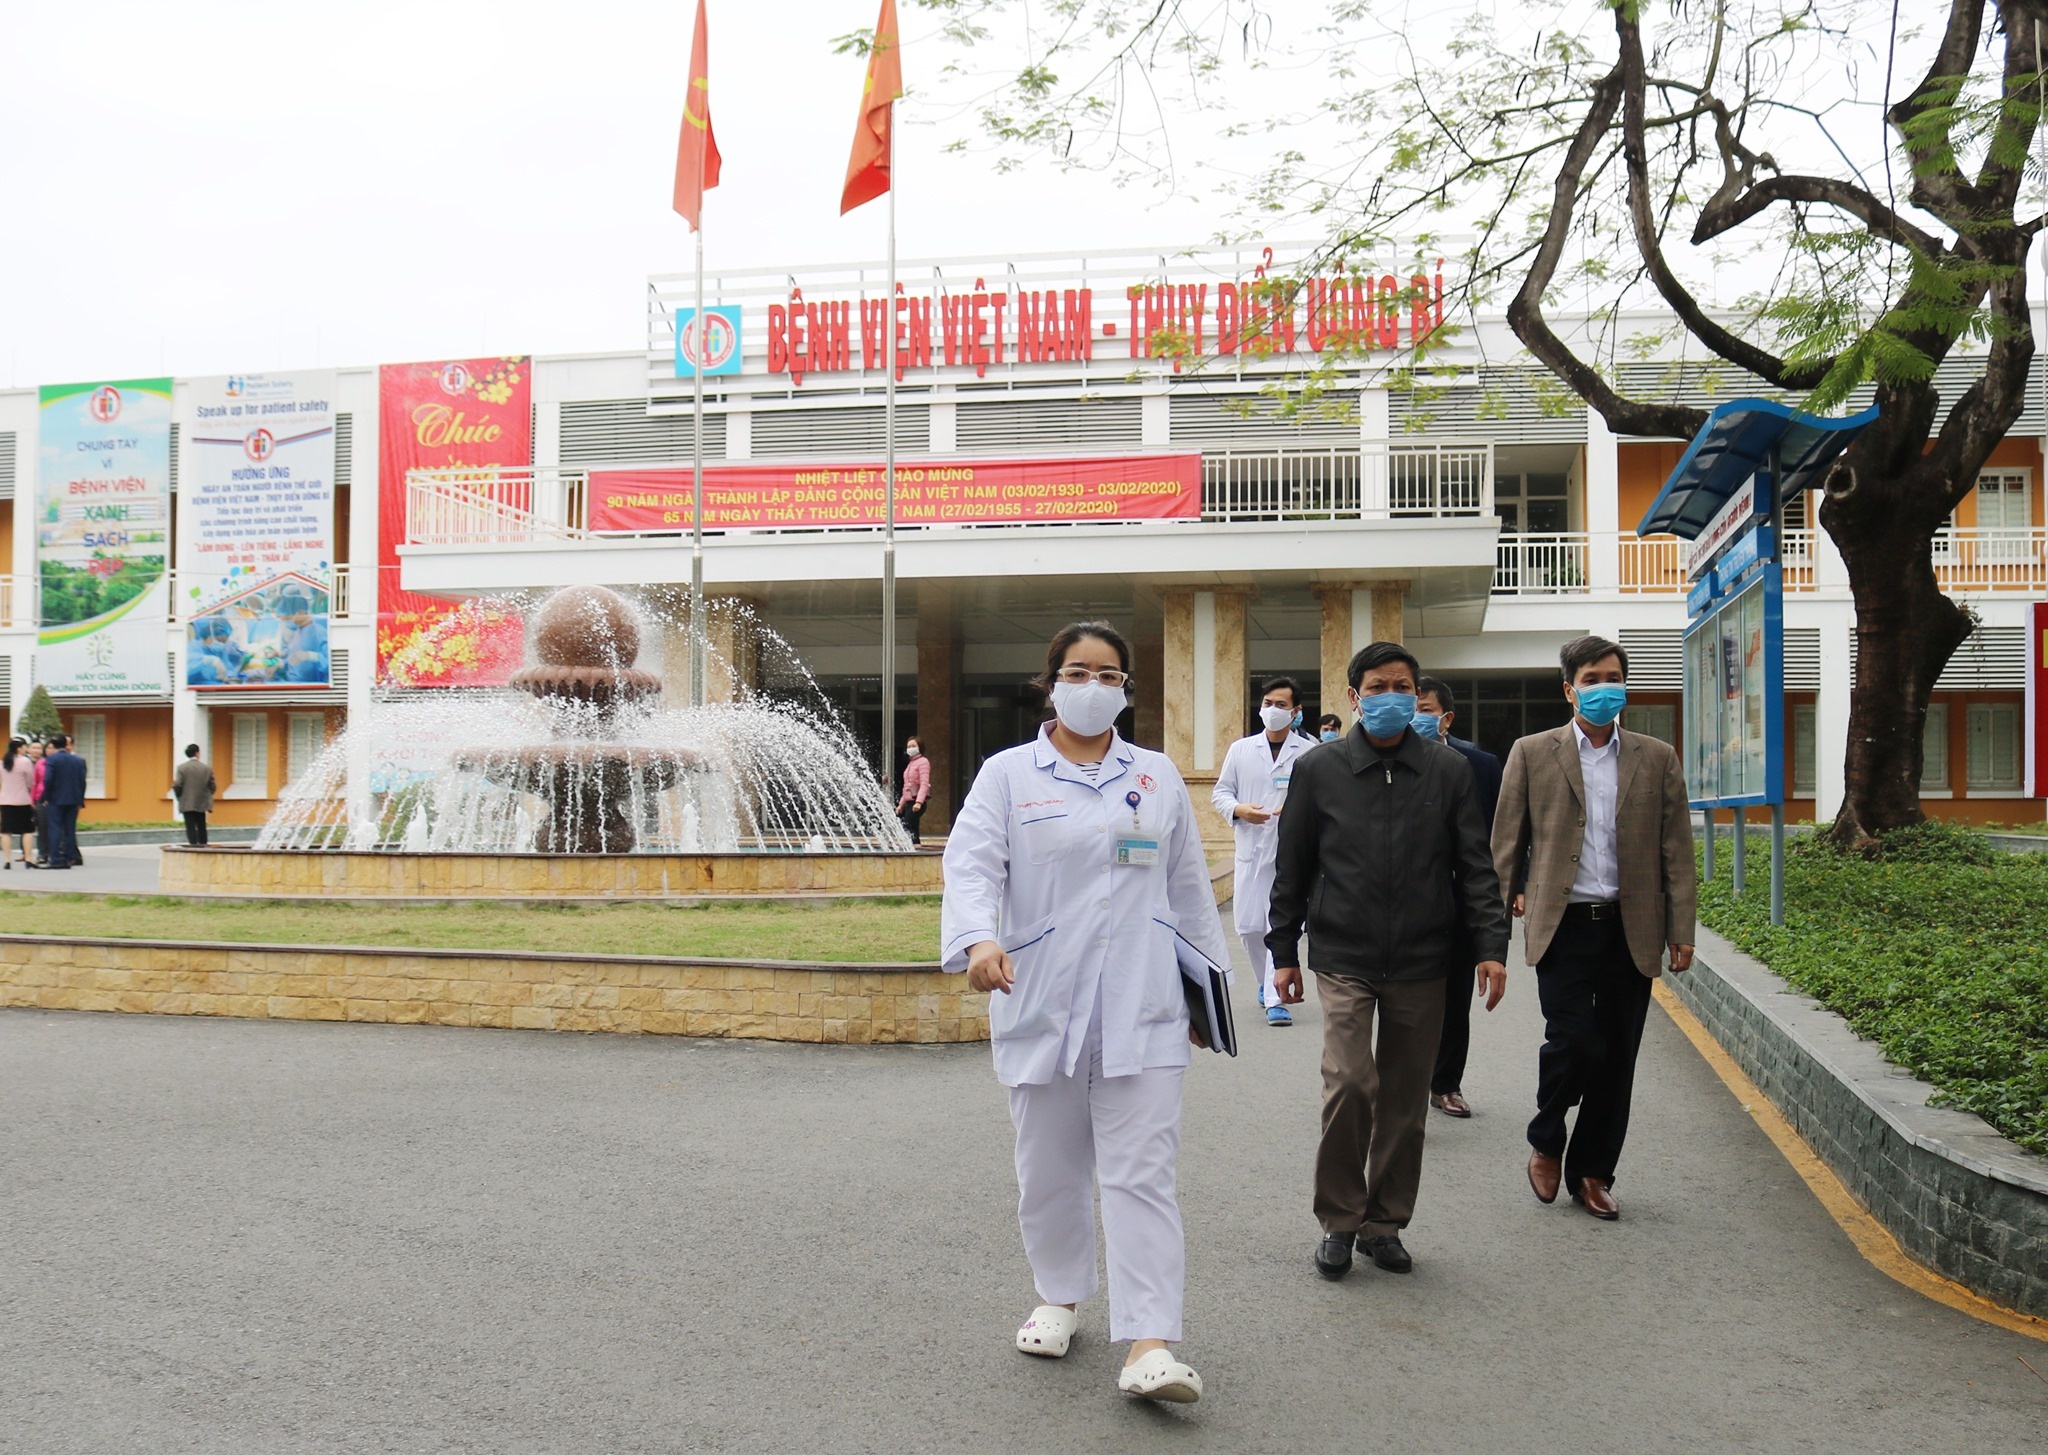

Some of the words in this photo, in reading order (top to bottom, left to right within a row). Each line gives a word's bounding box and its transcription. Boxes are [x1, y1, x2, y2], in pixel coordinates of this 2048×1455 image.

[768, 288, 849, 386] BỆNH
[860, 282, 931, 382] VIỆN
[941, 278, 1006, 378] VIỆT
[1018, 288, 1092, 363] NAM
[1127, 283, 1207, 373] THỤY
[1216, 246, 1294, 355] ĐIỂN
[1307, 260, 1398, 353] UÔNG
[1411, 258, 1445, 348] BÍ
[197, 405, 227, 418] Speak
[230, 406, 242, 417] up
[245, 403, 259, 415] for
[261, 401, 296, 415] patient
[298, 399, 329, 412] safety
[411, 403, 502, 447] Chúc
[77, 440, 114, 452] CHUNG
[118, 439, 138, 450] TAY
[69, 477, 108, 495] BỆNH
[111, 475, 145, 495] VIỆN
[795, 469, 840, 486] NHIỆT
[844, 468, 877, 485] LIỆT
[928, 466, 974, 482] MỪNG
[607, 496, 623, 508] 90
[627, 492, 658, 507] NĂM
[662, 491, 694, 505] NGÀ
[707, 489, 758, 504] THÀNH
[762, 488, 790, 506] LẬP
[794, 485, 837, 502] ĐẢNG
[841, 486, 885, 503] CỘNG
[893, 483, 921, 500] SẢN
[925, 484, 959, 501] VIỆT
[963, 486, 997, 498] NAM
[1002, 484, 1084, 500] (03/02/1930
[1098, 481, 1181, 496] 03/02/2020)
[84, 504, 129, 521] XANH
[663, 511, 679, 523] 65
[684, 508, 715, 522] NM
[720, 506, 761, 521] NGÀY
[766, 503, 804, 521] THẦY
[809, 502, 860, 519] THUỐC
[902, 504, 936, 517] NAM
[940, 503, 1021, 519] (27/02/1955
[1035, 500, 1118, 515] 27/02/2020)
[83, 531, 128, 550] SẠCH
